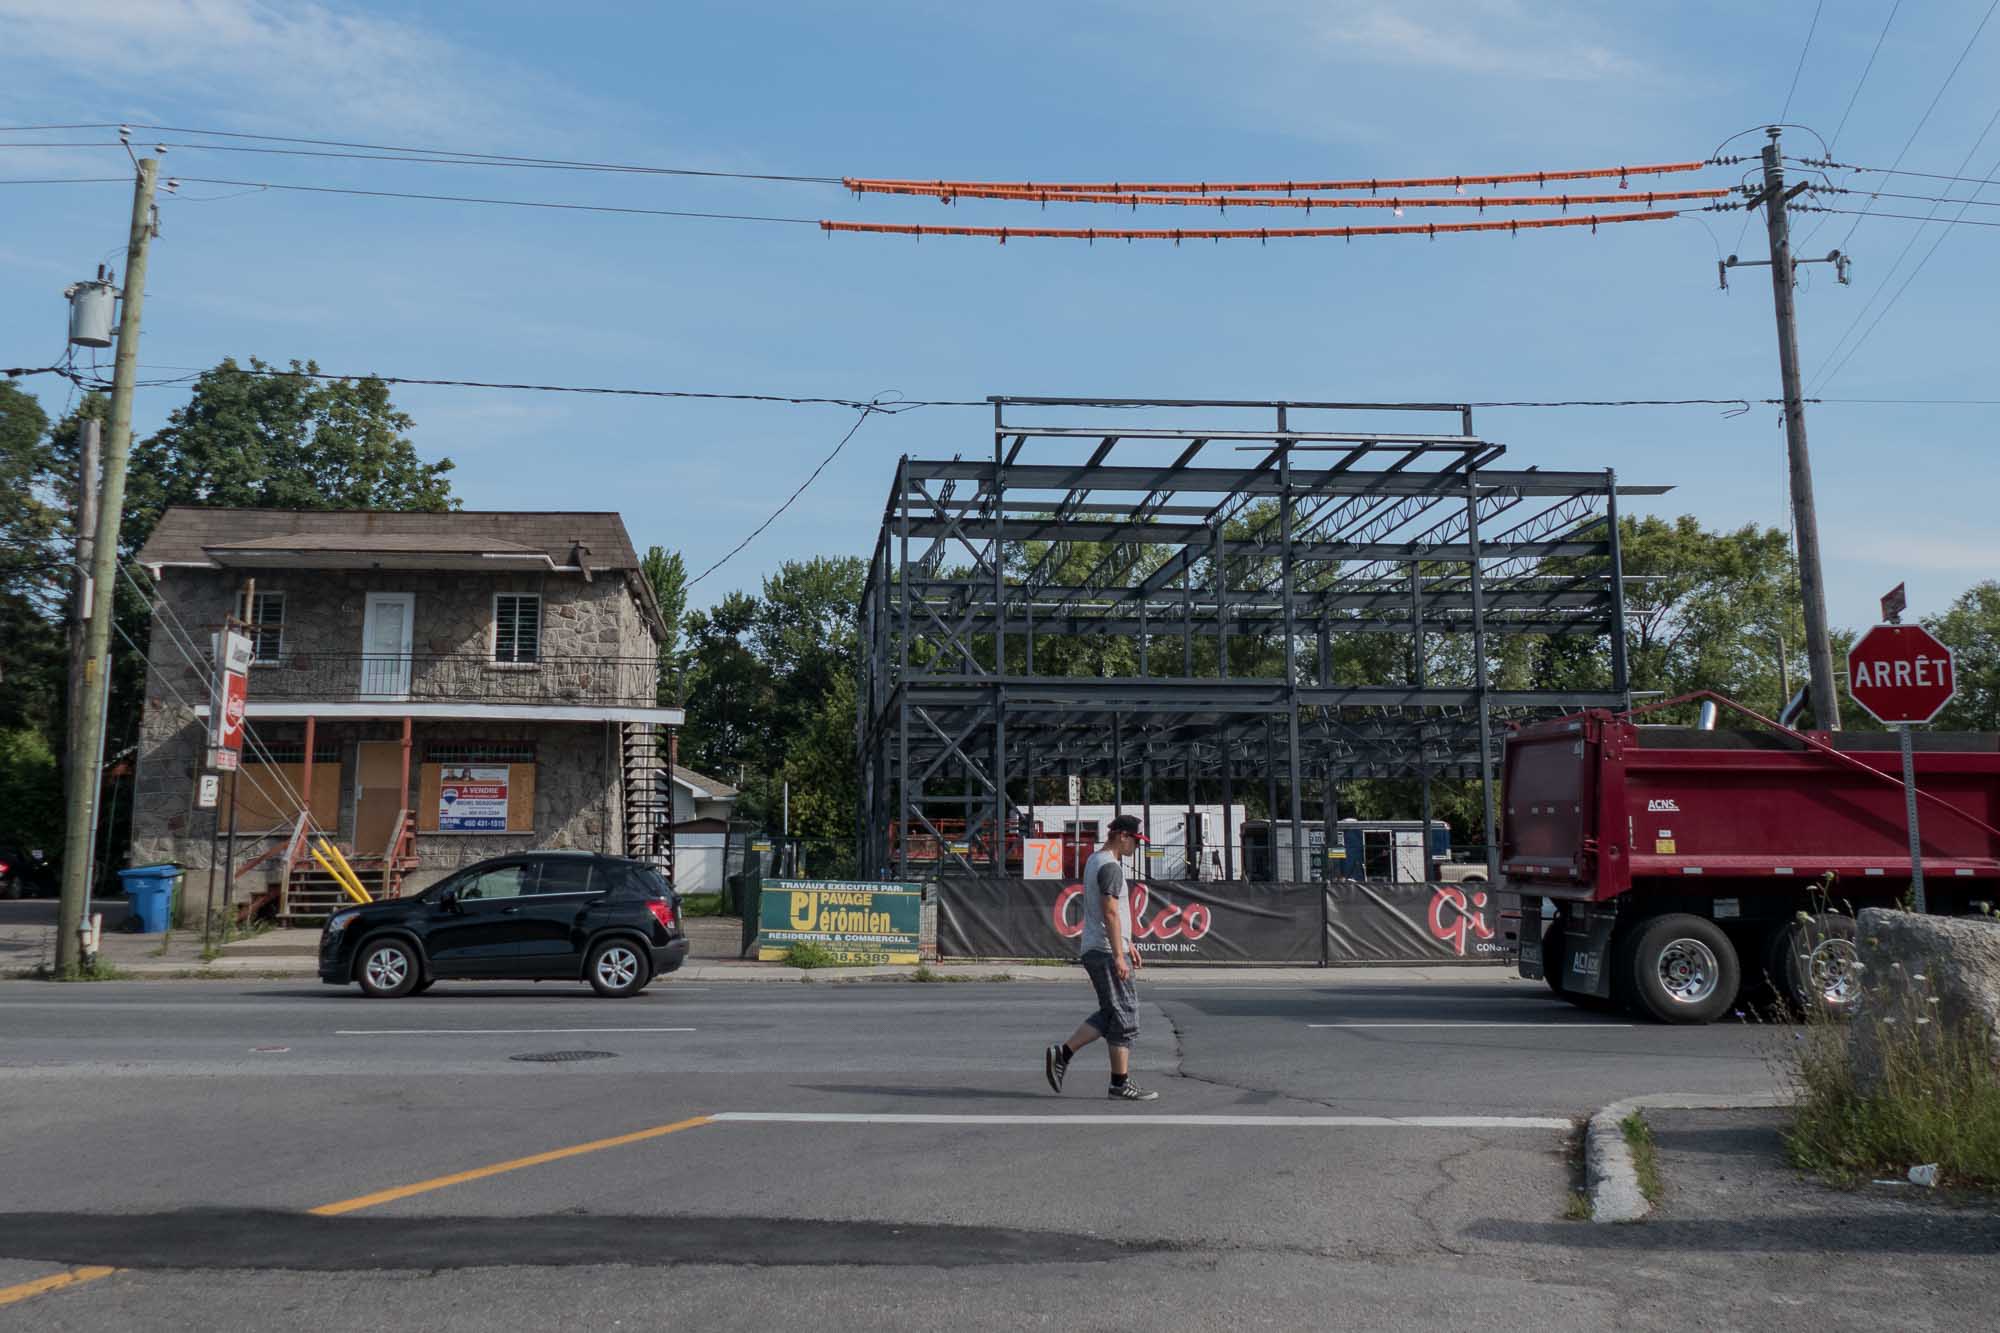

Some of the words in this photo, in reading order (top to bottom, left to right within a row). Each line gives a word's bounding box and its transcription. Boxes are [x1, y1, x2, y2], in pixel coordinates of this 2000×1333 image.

[1855, 654, 1948, 688] ARRÊT
[1648, 799, 1675, 809] ACNS
[1028, 838, 1062, 876] 78
[780, 881, 825, 890] TRAVAUX
[820, 893, 873, 906] PAVAGE
[844, 934, 911, 943] COMMERCIAL
[1180, 943, 1200, 952] INC.
